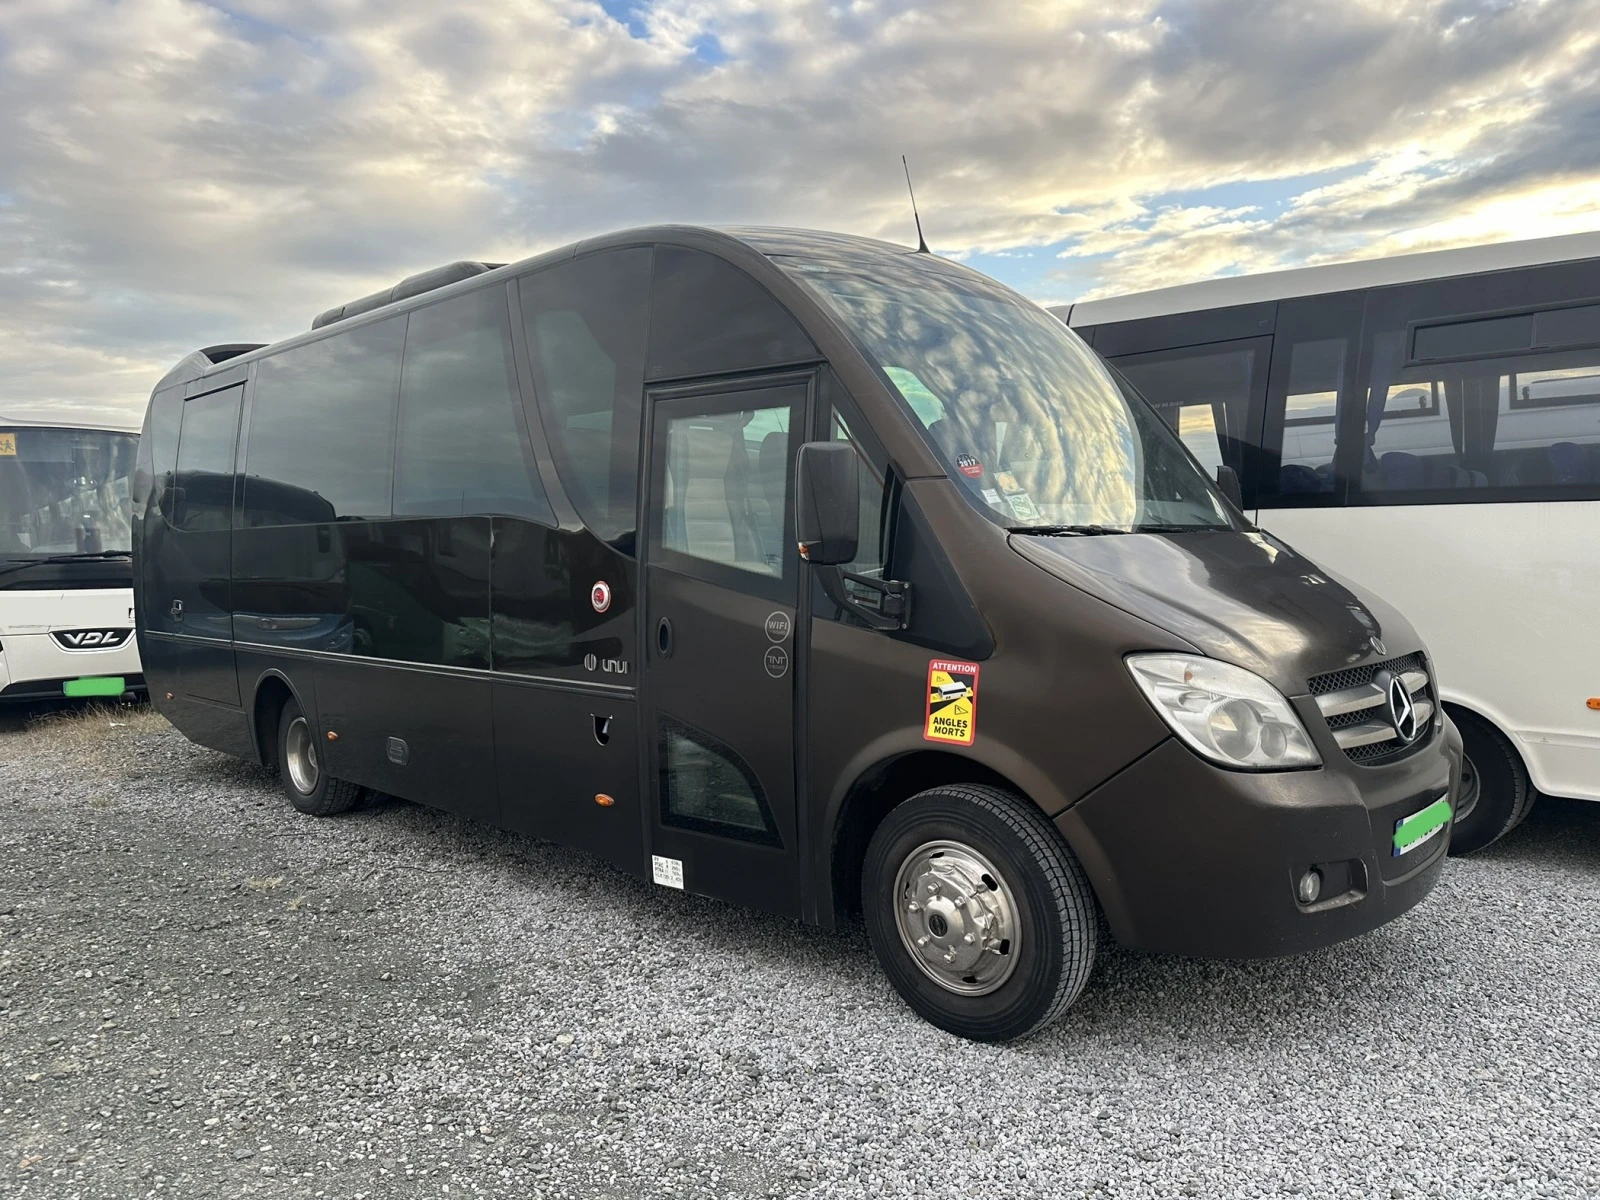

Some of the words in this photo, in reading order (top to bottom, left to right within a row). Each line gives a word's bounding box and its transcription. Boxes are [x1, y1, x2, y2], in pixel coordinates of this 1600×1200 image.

[959, 459, 976, 467] 2017
[768, 620, 788, 630] WIFI
[64, 632, 120, 645] VDL
[767, 655, 786, 665] TNT
[933, 663, 976, 672] ATTENTION
[933, 717, 967, 728] ANGLES
[934, 726, 965, 737] MORTS
